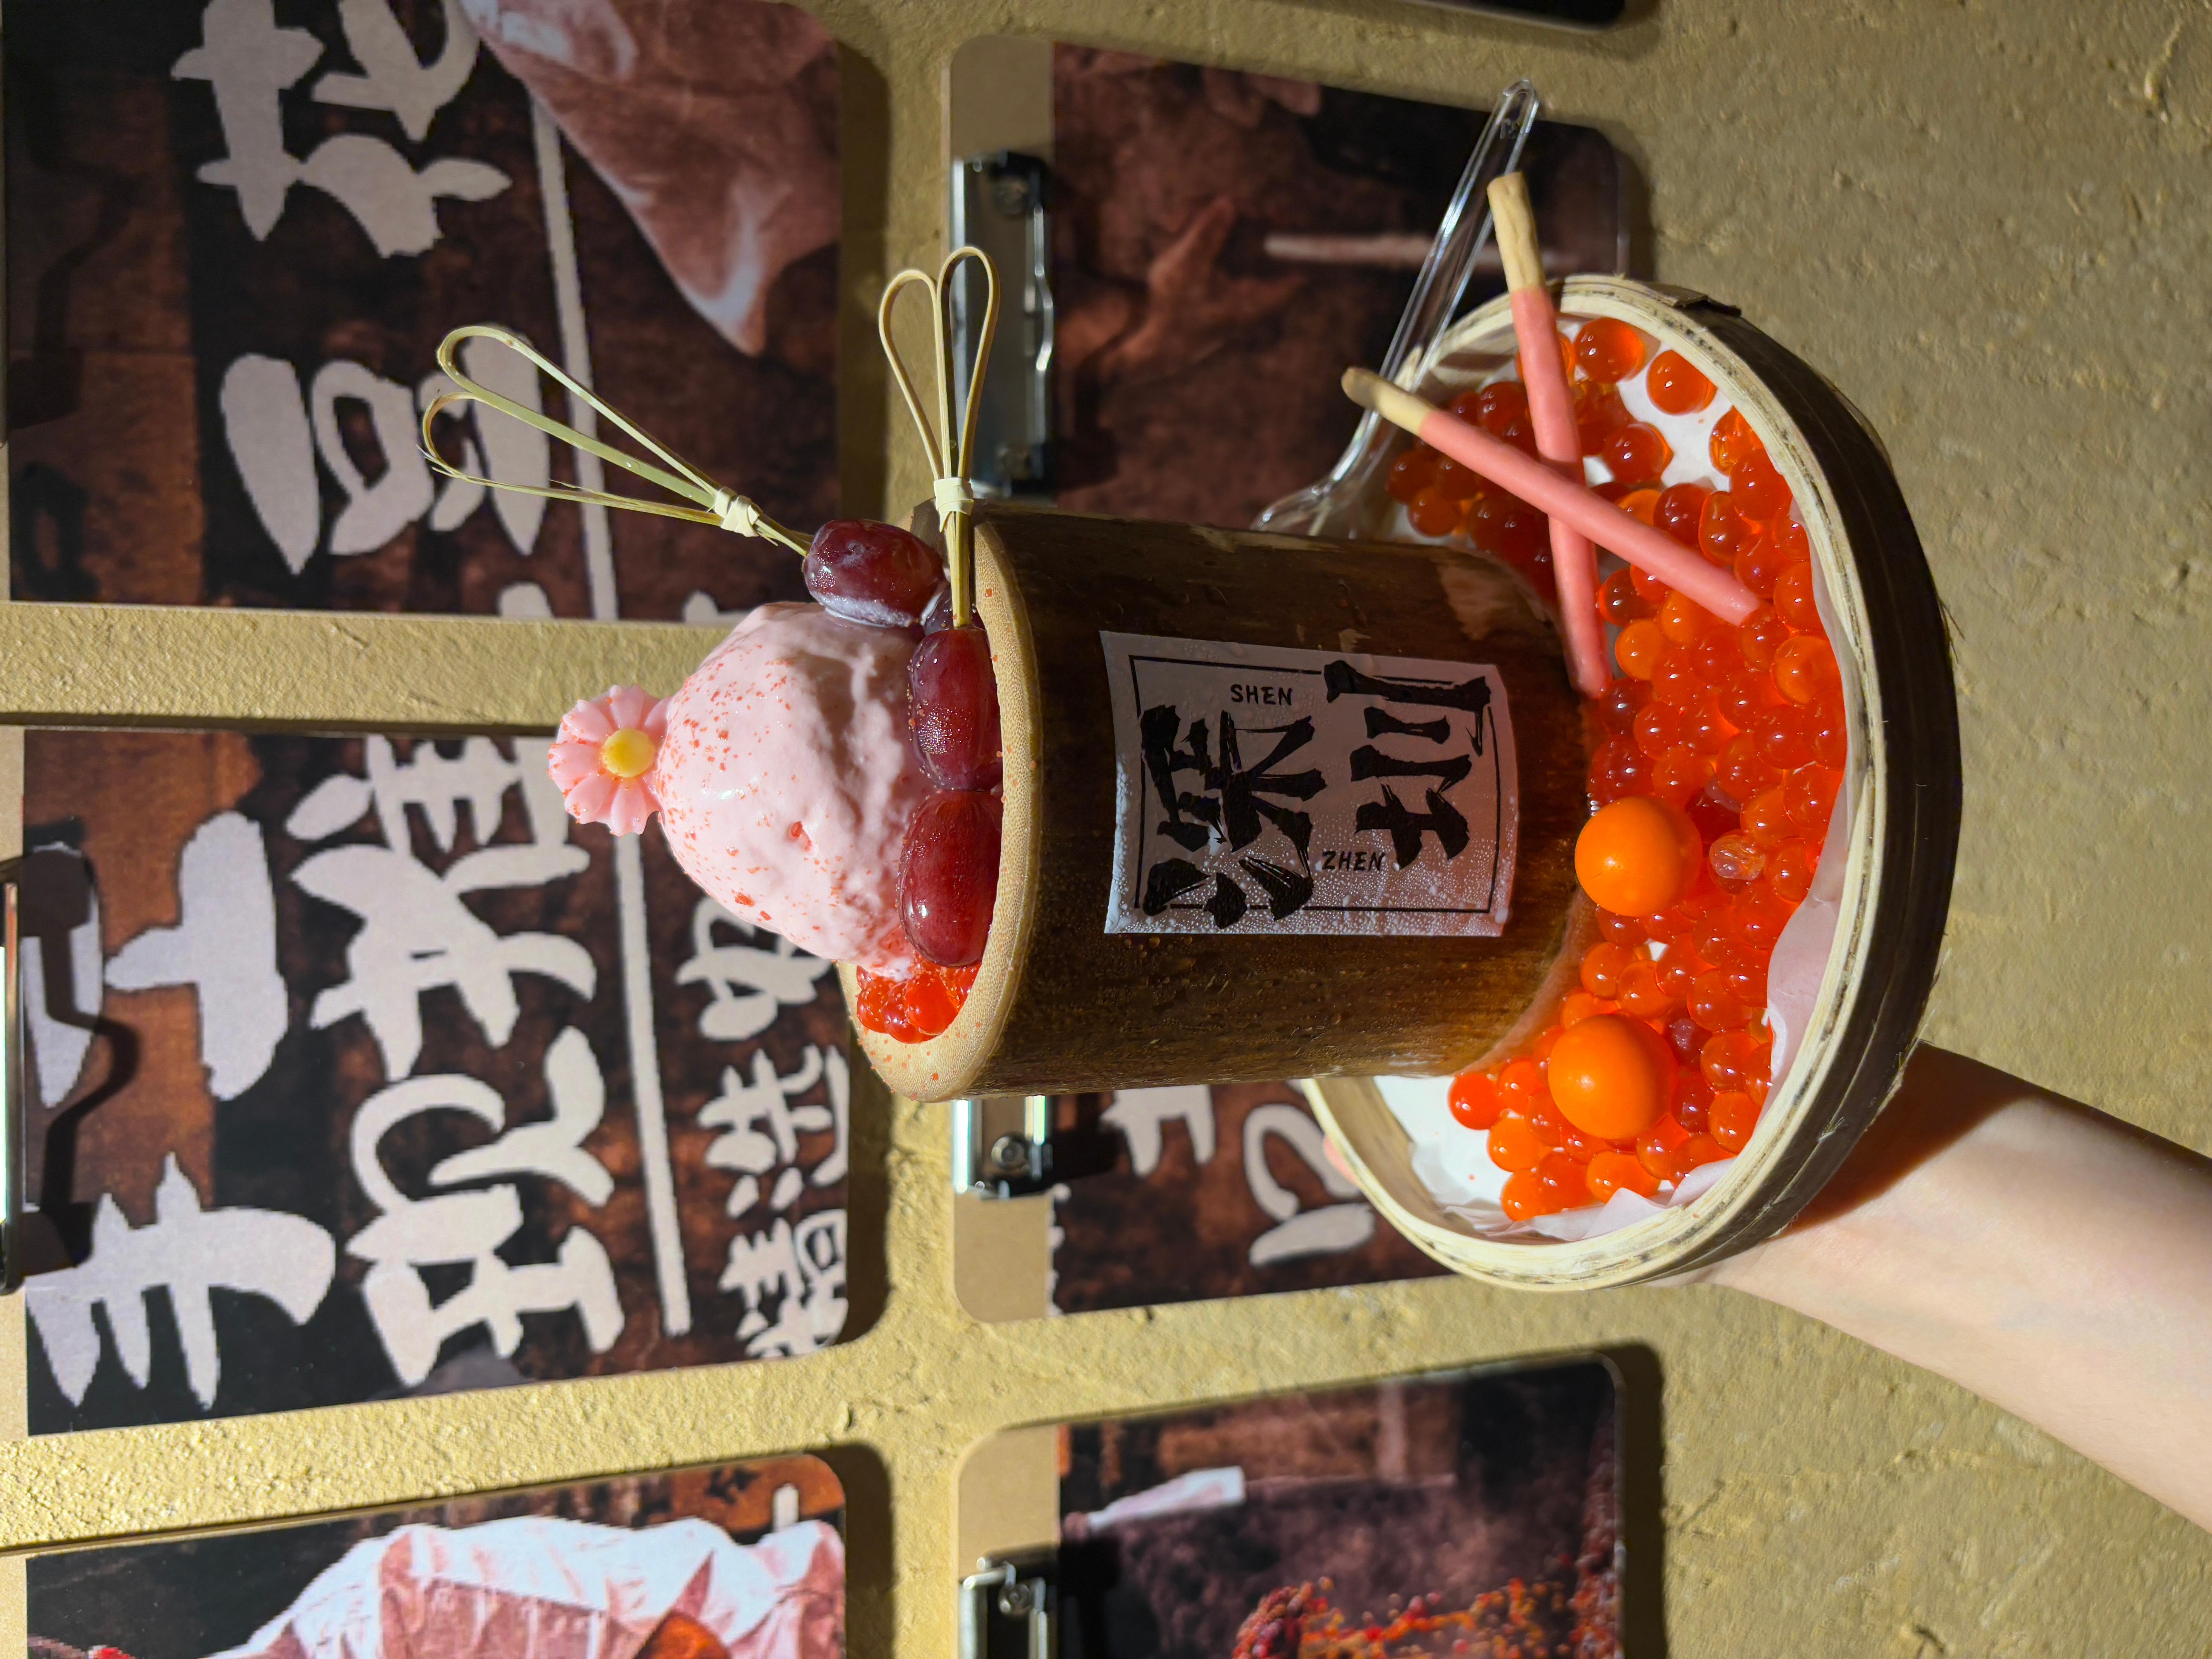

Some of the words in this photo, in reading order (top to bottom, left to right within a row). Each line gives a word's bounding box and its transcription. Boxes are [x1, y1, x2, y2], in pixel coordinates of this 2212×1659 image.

[170, 0, 550, 575] 豆花
[1140, 660, 1491, 929] 深圳
[1230, 684, 1293, 706] SHEN
[1322, 851, 1385, 871] ZHEN
[22, 811, 336, 1409] 手工
